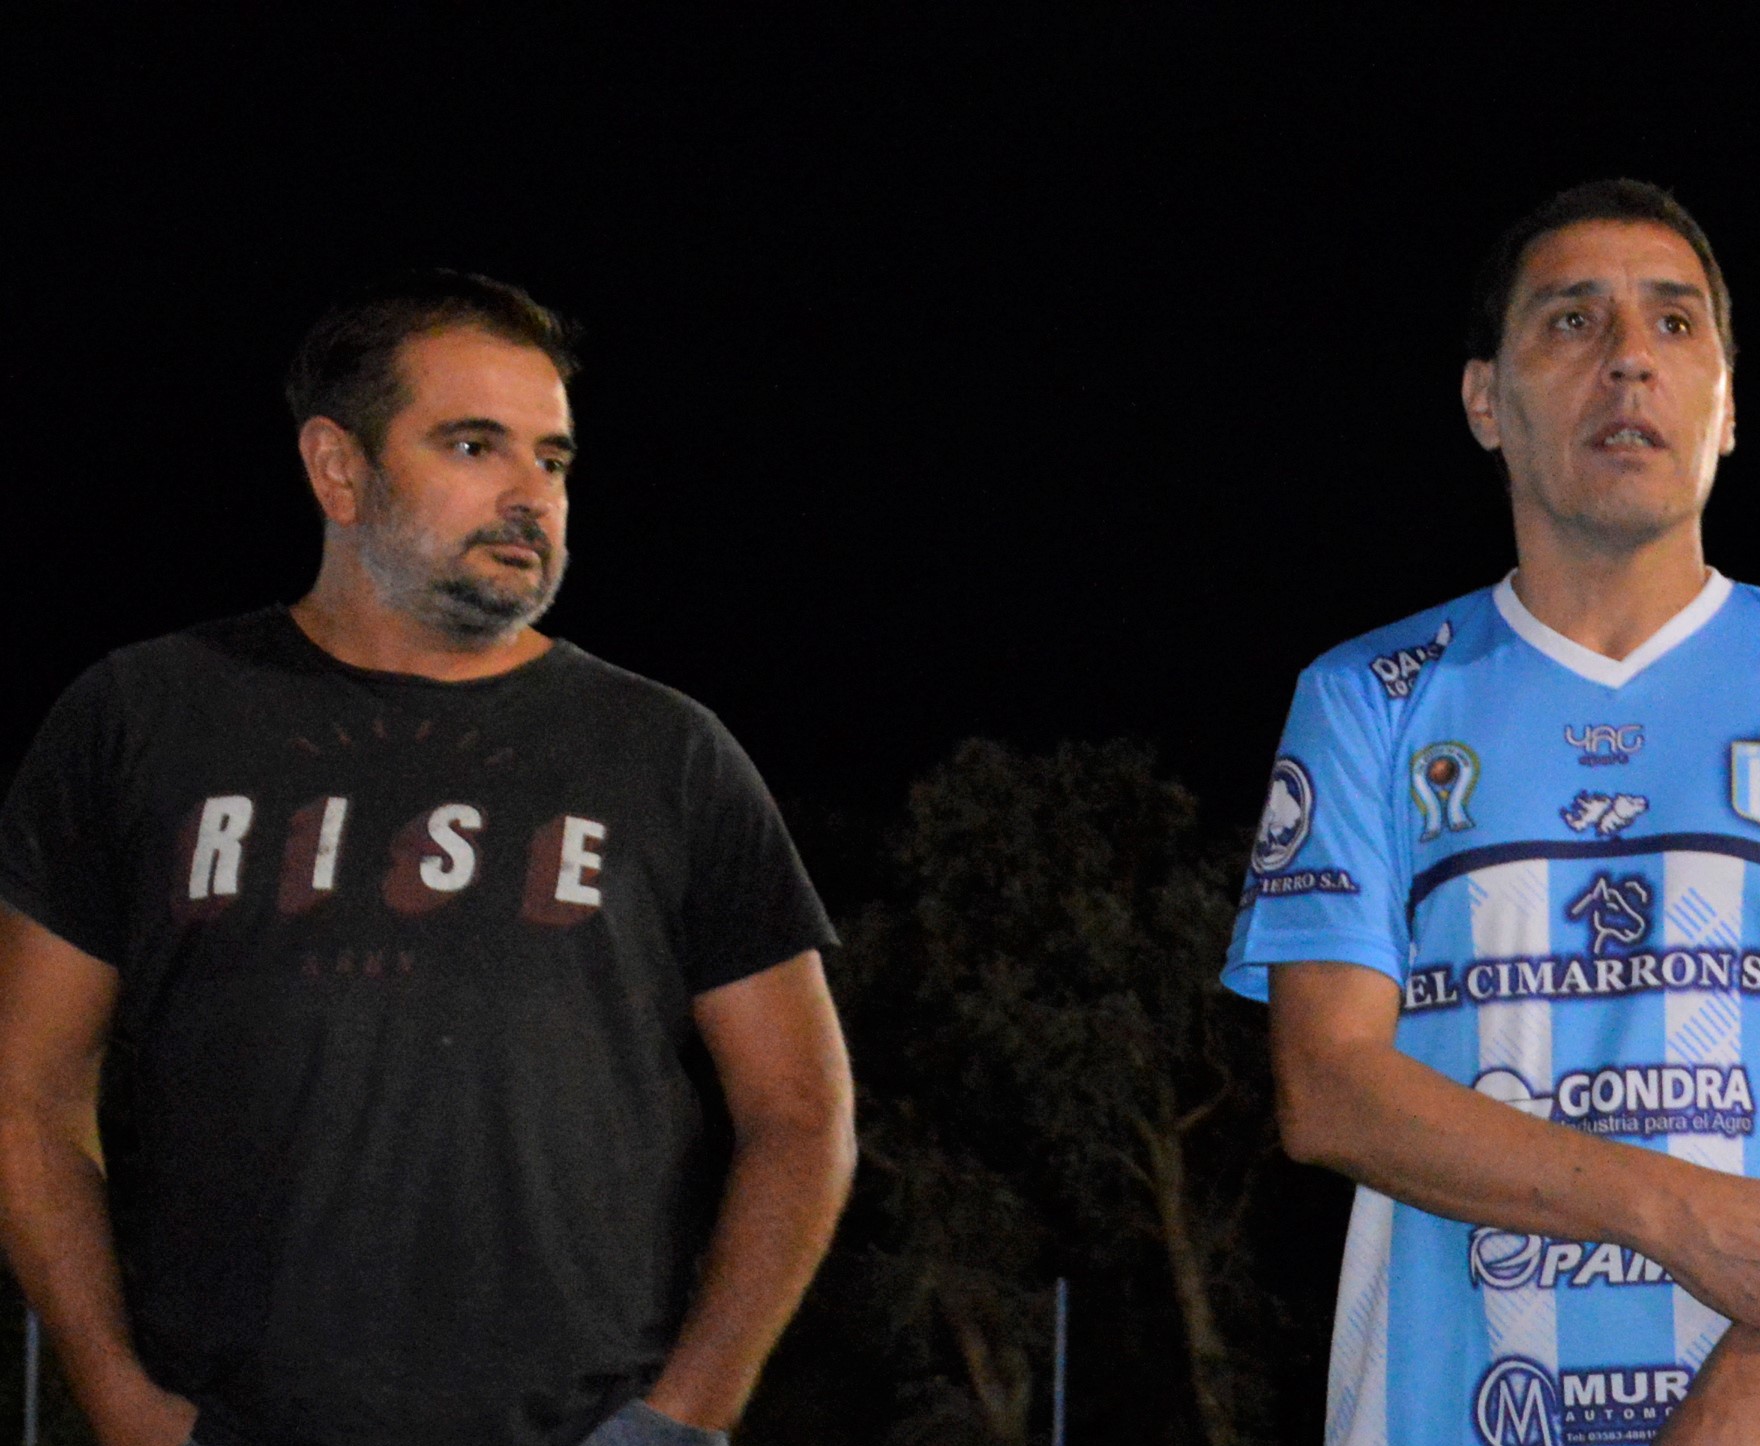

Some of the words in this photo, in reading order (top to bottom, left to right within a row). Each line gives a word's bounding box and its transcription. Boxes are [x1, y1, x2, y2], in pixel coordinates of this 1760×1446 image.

[188, 795, 607, 906] RISE
[1404, 970, 1458, 1009] EL
[1467, 952, 1732, 1000] CIMARRON
[1558, 1067, 1753, 1117] GONDRA
[1644, 1114, 1688, 1134] para
[1692, 1112, 1709, 1130] el
[1711, 1111, 1752, 1133] Agro
